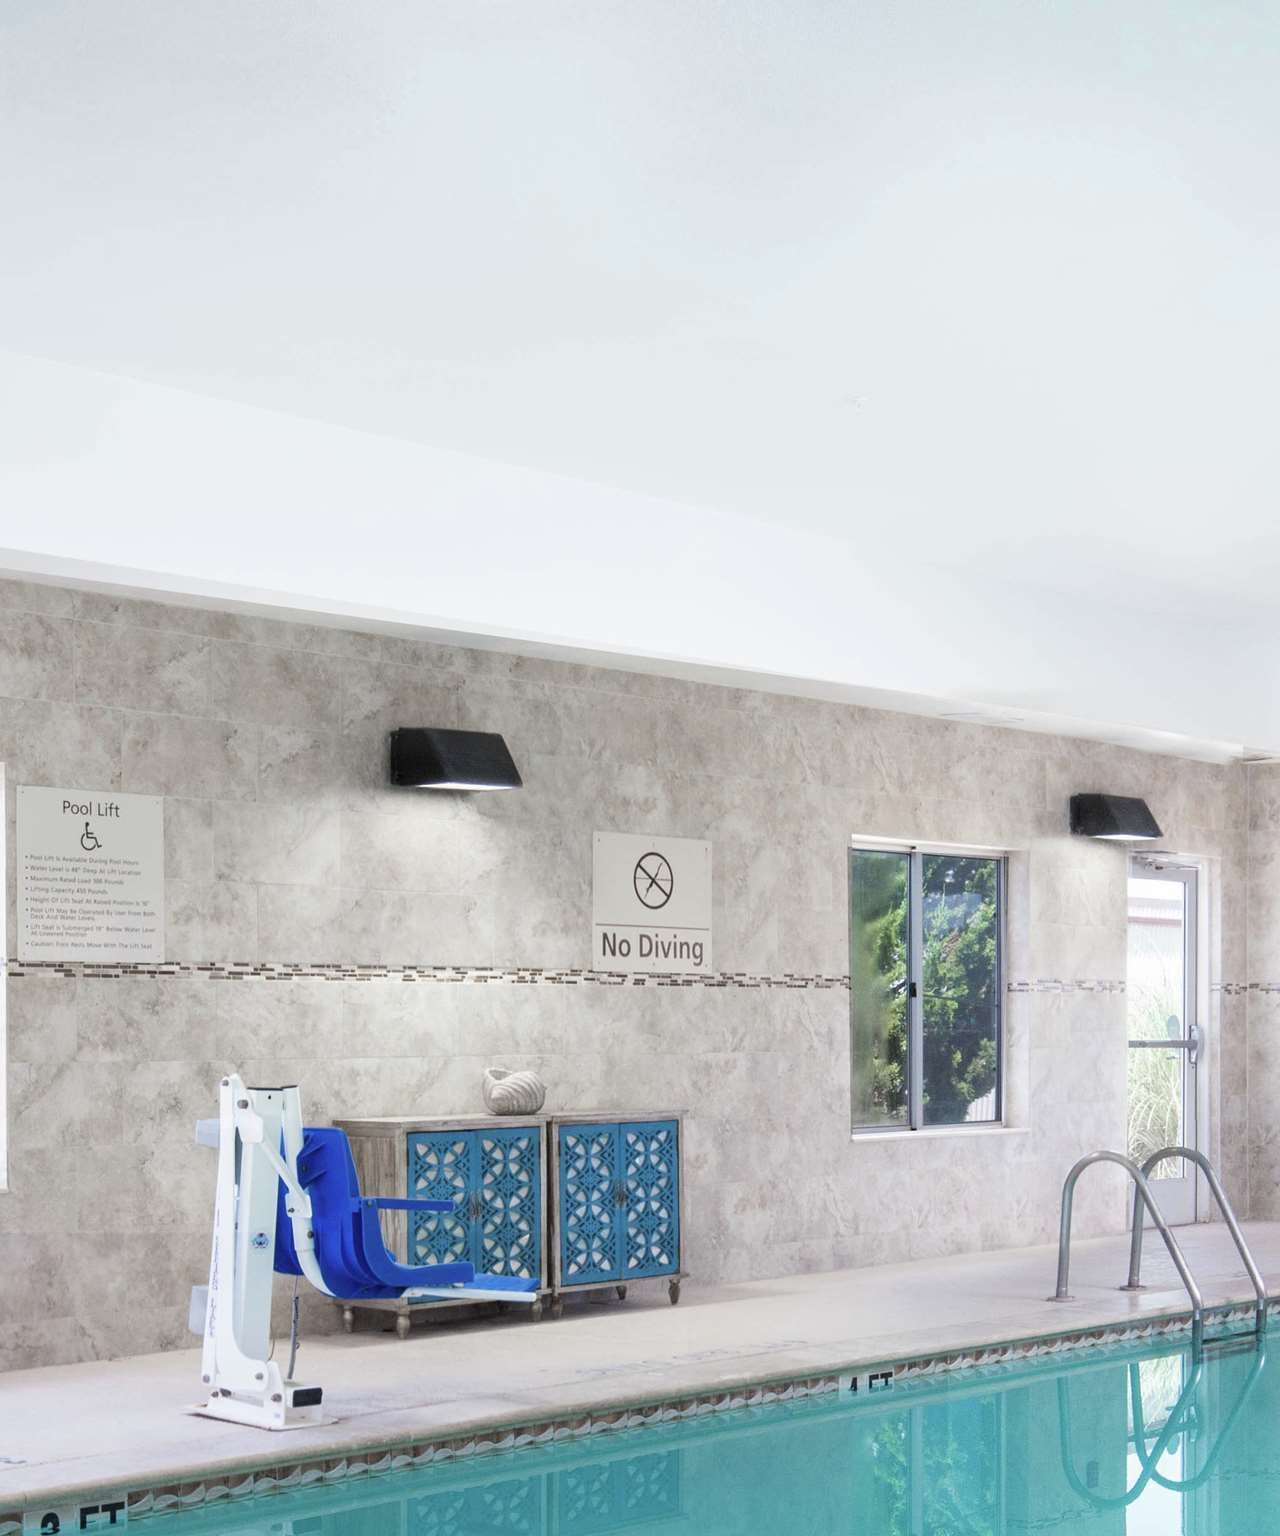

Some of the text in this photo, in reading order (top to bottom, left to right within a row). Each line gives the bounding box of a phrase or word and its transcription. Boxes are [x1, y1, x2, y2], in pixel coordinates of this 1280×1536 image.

[62, 800, 120, 818] Pool Lift
[602, 932, 703, 967] No Diving
